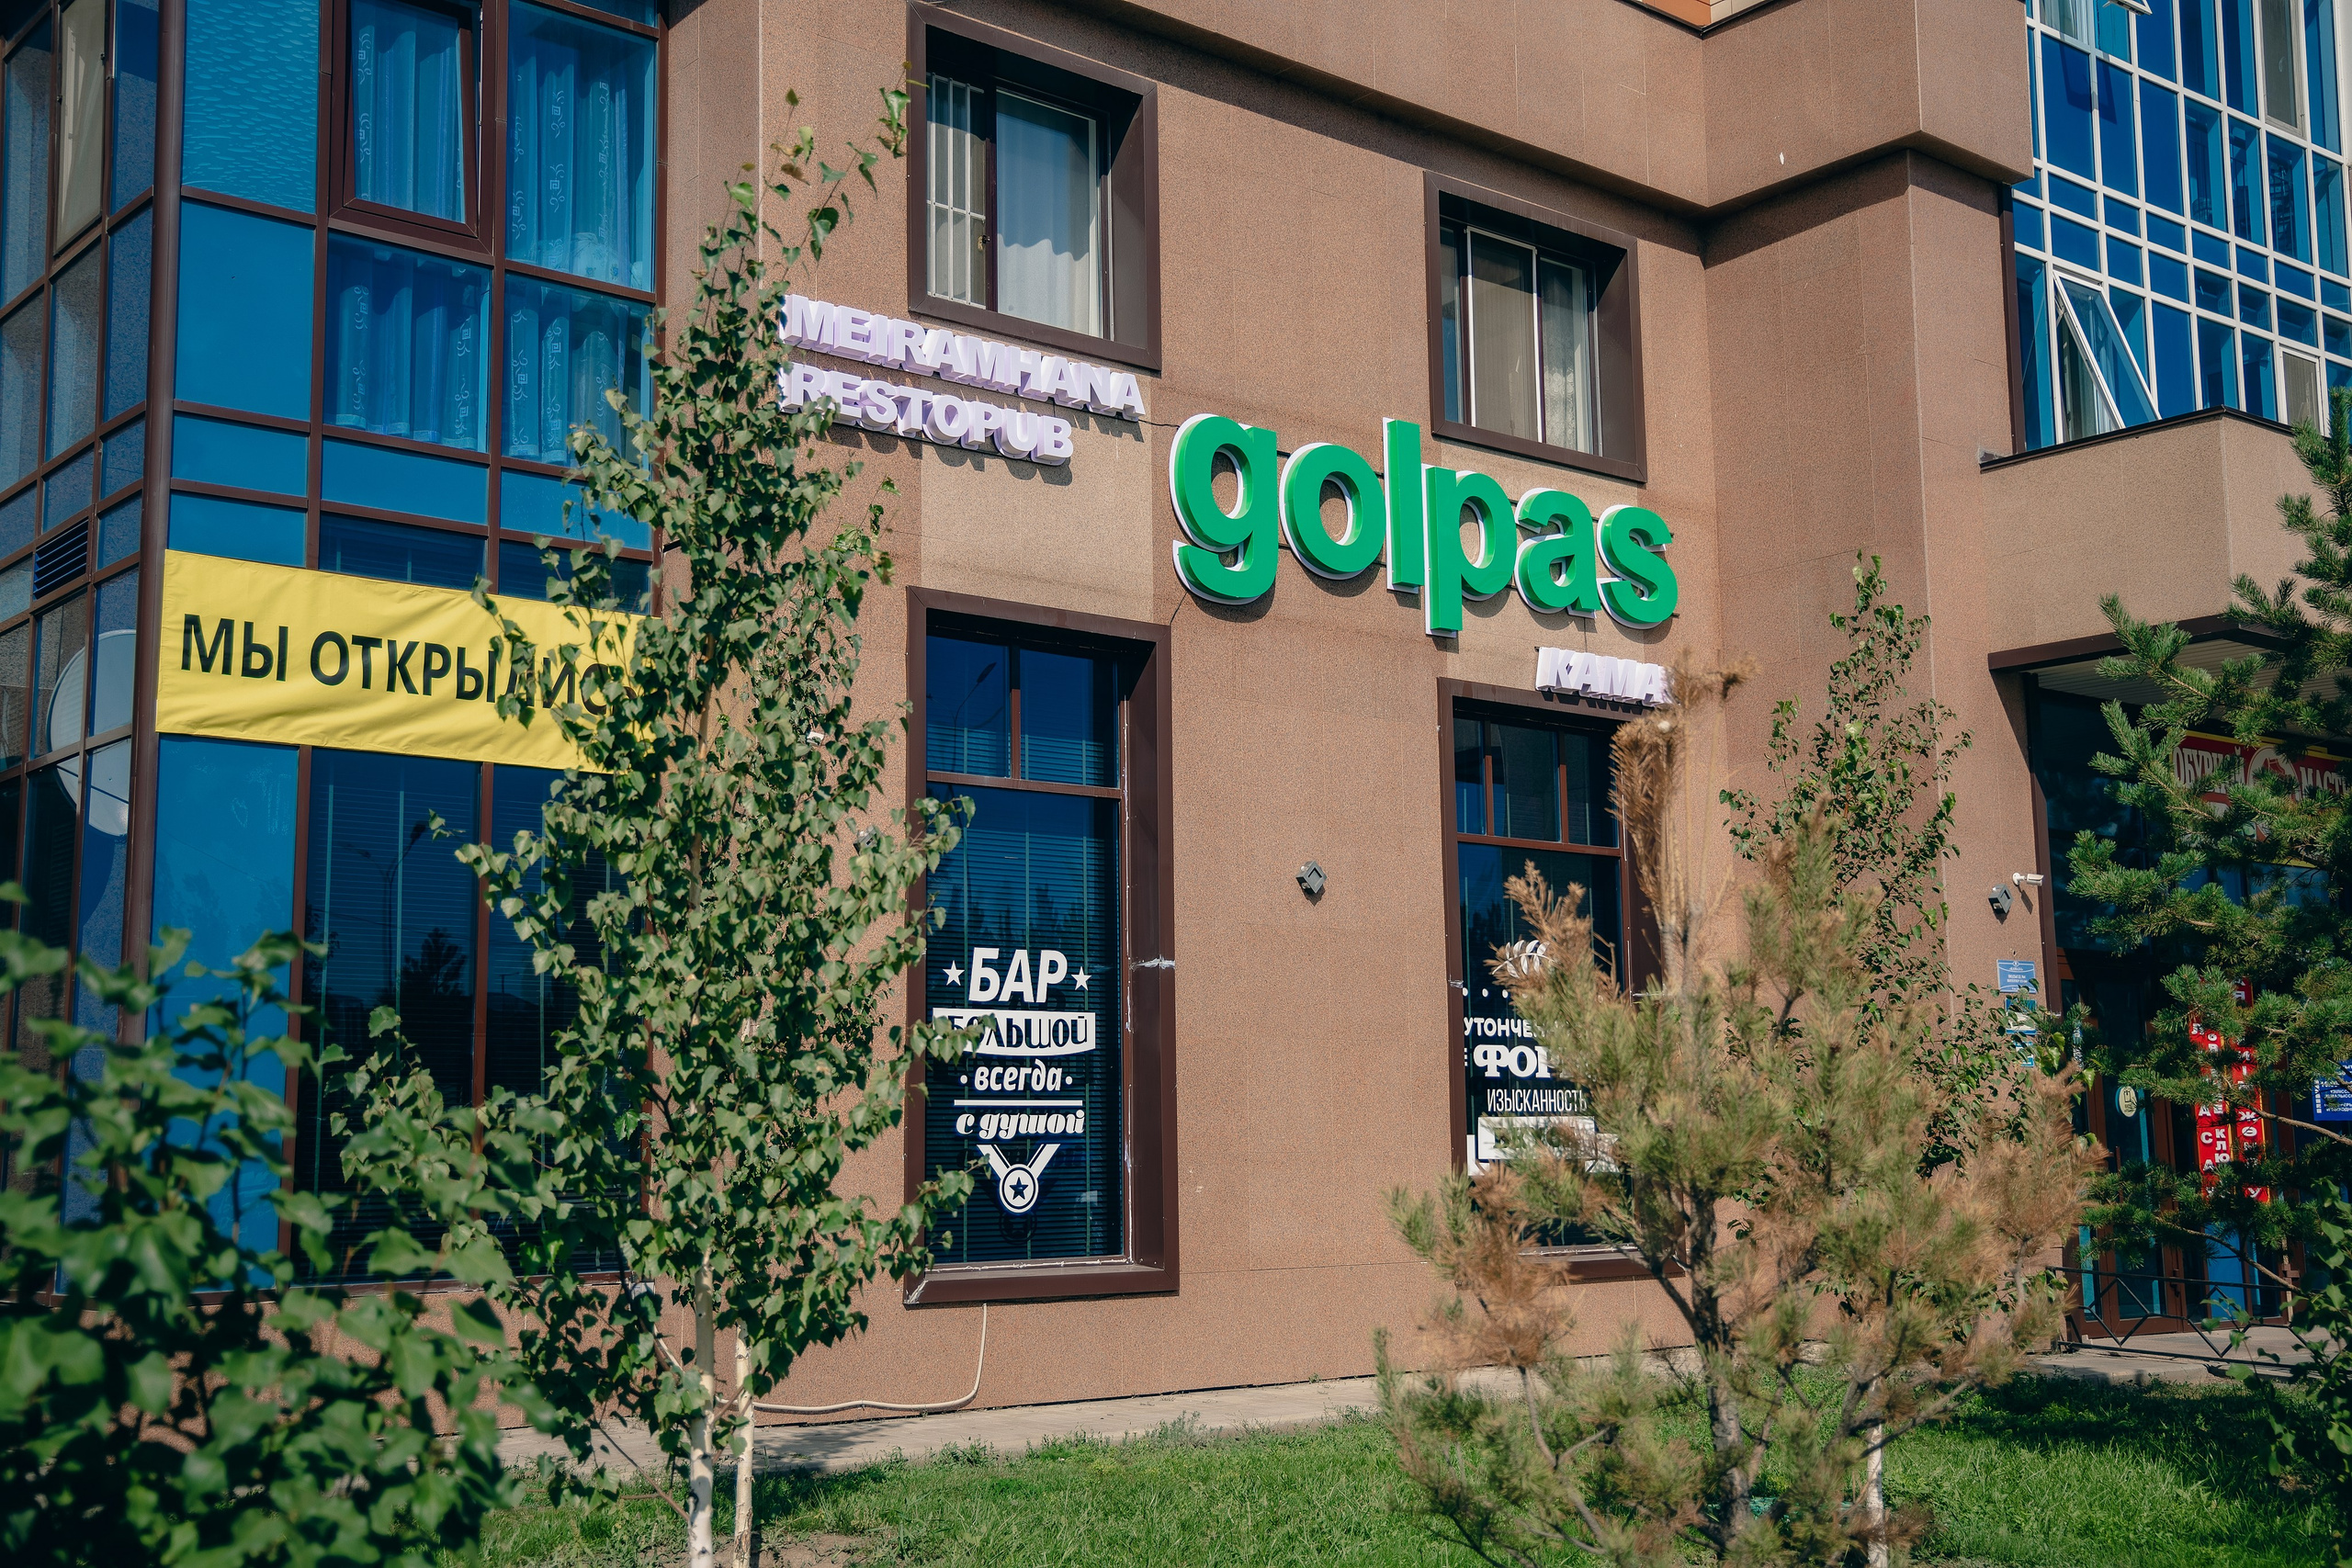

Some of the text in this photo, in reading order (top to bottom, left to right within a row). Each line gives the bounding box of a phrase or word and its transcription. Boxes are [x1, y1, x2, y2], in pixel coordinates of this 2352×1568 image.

[780, 294, 1147, 423] MEIRAMHANA
[778, 362, 1074, 466] RESTOPUB
[1170, 413, 1679, 638] golpas
[181, 613, 638, 716] МЫ ОТКРЫЛИС
[1536, 646, 1679, 707] KAMA
[2173, 746, 2246, 794] ОБУВНЙ
[968, 946, 1069, 1003] БАР
[1464, 1017, 1548, 1038] УТОНЧЕ
[974, 1058, 1063, 1091] всегда
[1473, 1043, 1574, 1079] ФОР
[978, 1109, 1086, 1140] душой
[1487, 1089, 1588, 1112] ИЗЫСКАННОСТЬ
